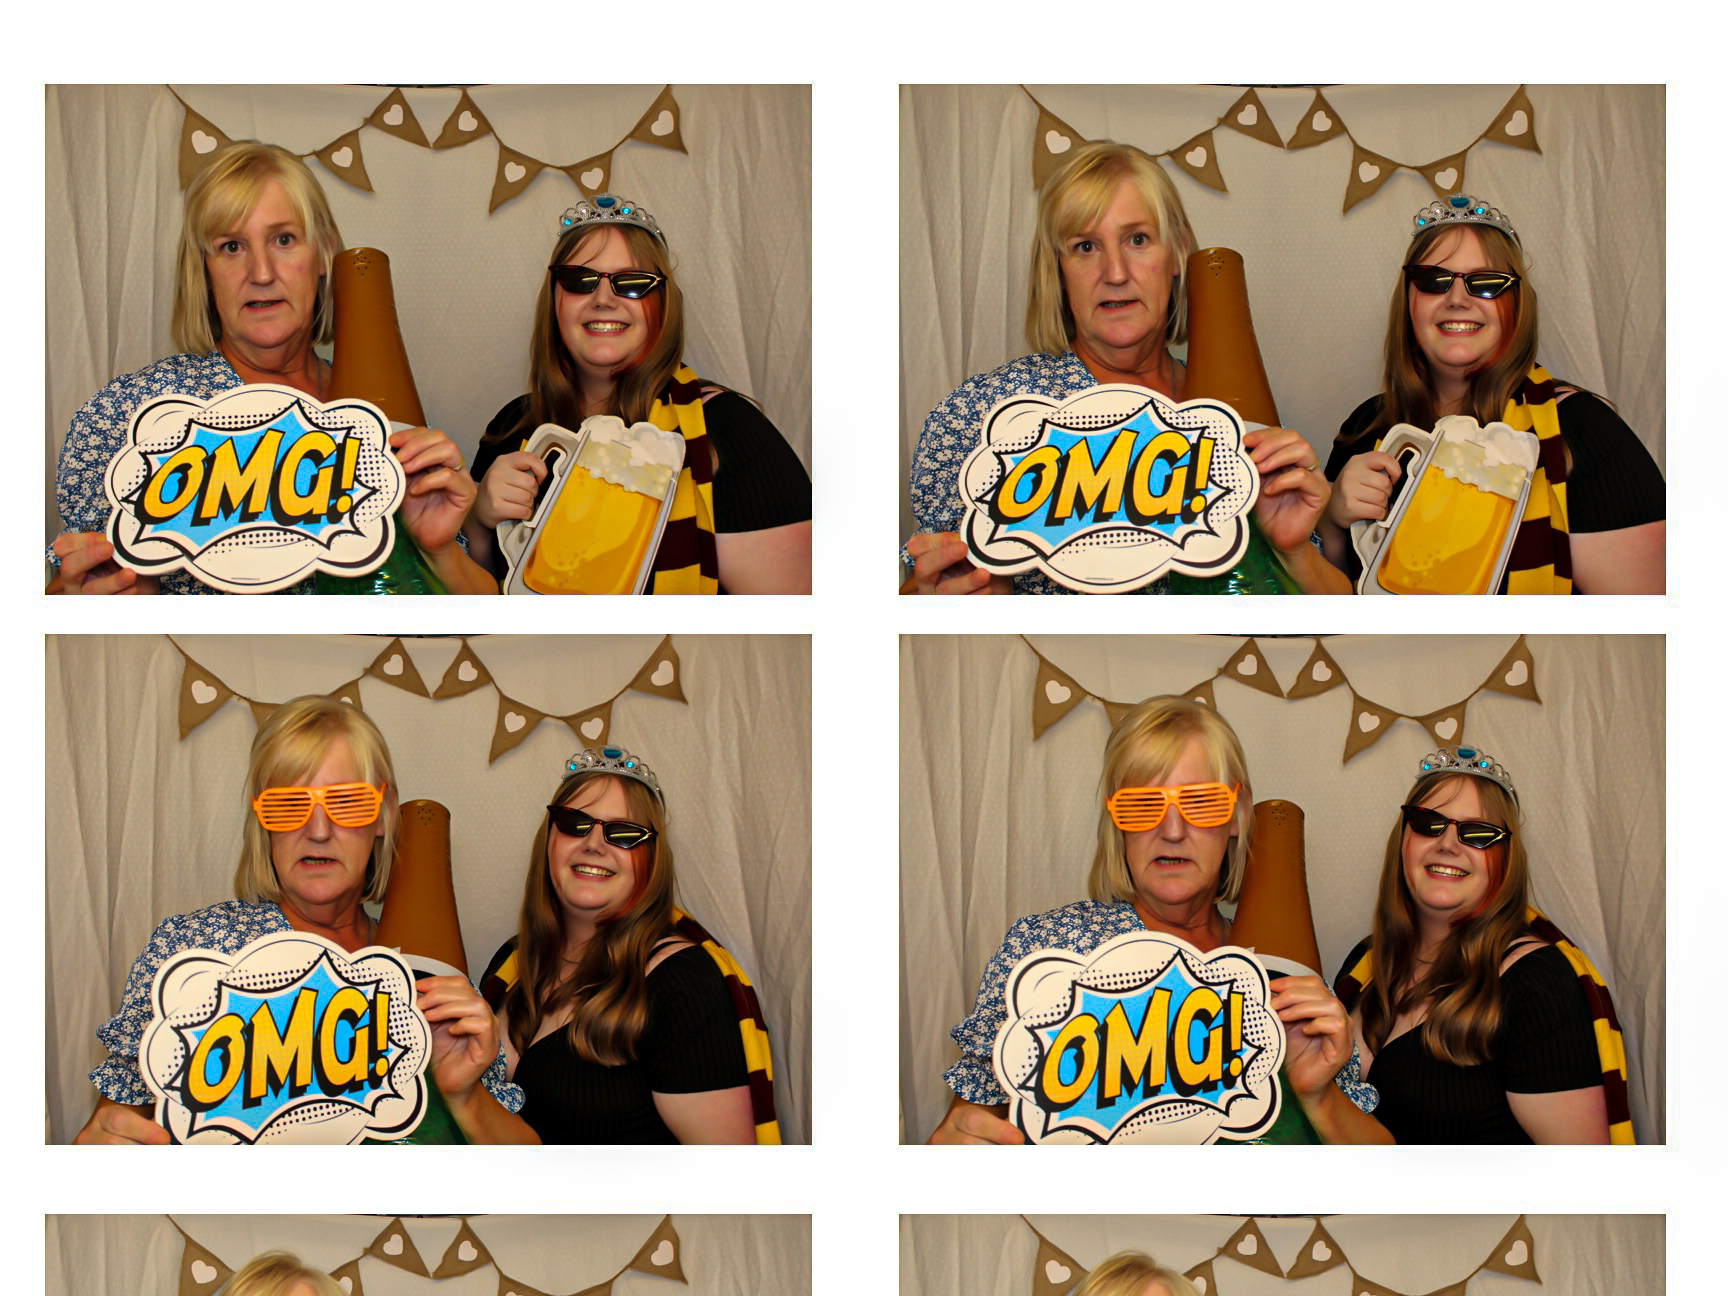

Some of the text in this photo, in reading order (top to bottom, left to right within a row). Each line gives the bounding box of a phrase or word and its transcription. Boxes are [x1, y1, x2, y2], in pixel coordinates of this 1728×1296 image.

[138, 428, 361, 525] OMG!
[992, 428, 1215, 525] OMG!
[182, 986, 392, 1109] OMG!
[1035, 986, 1246, 1109] OMG!
